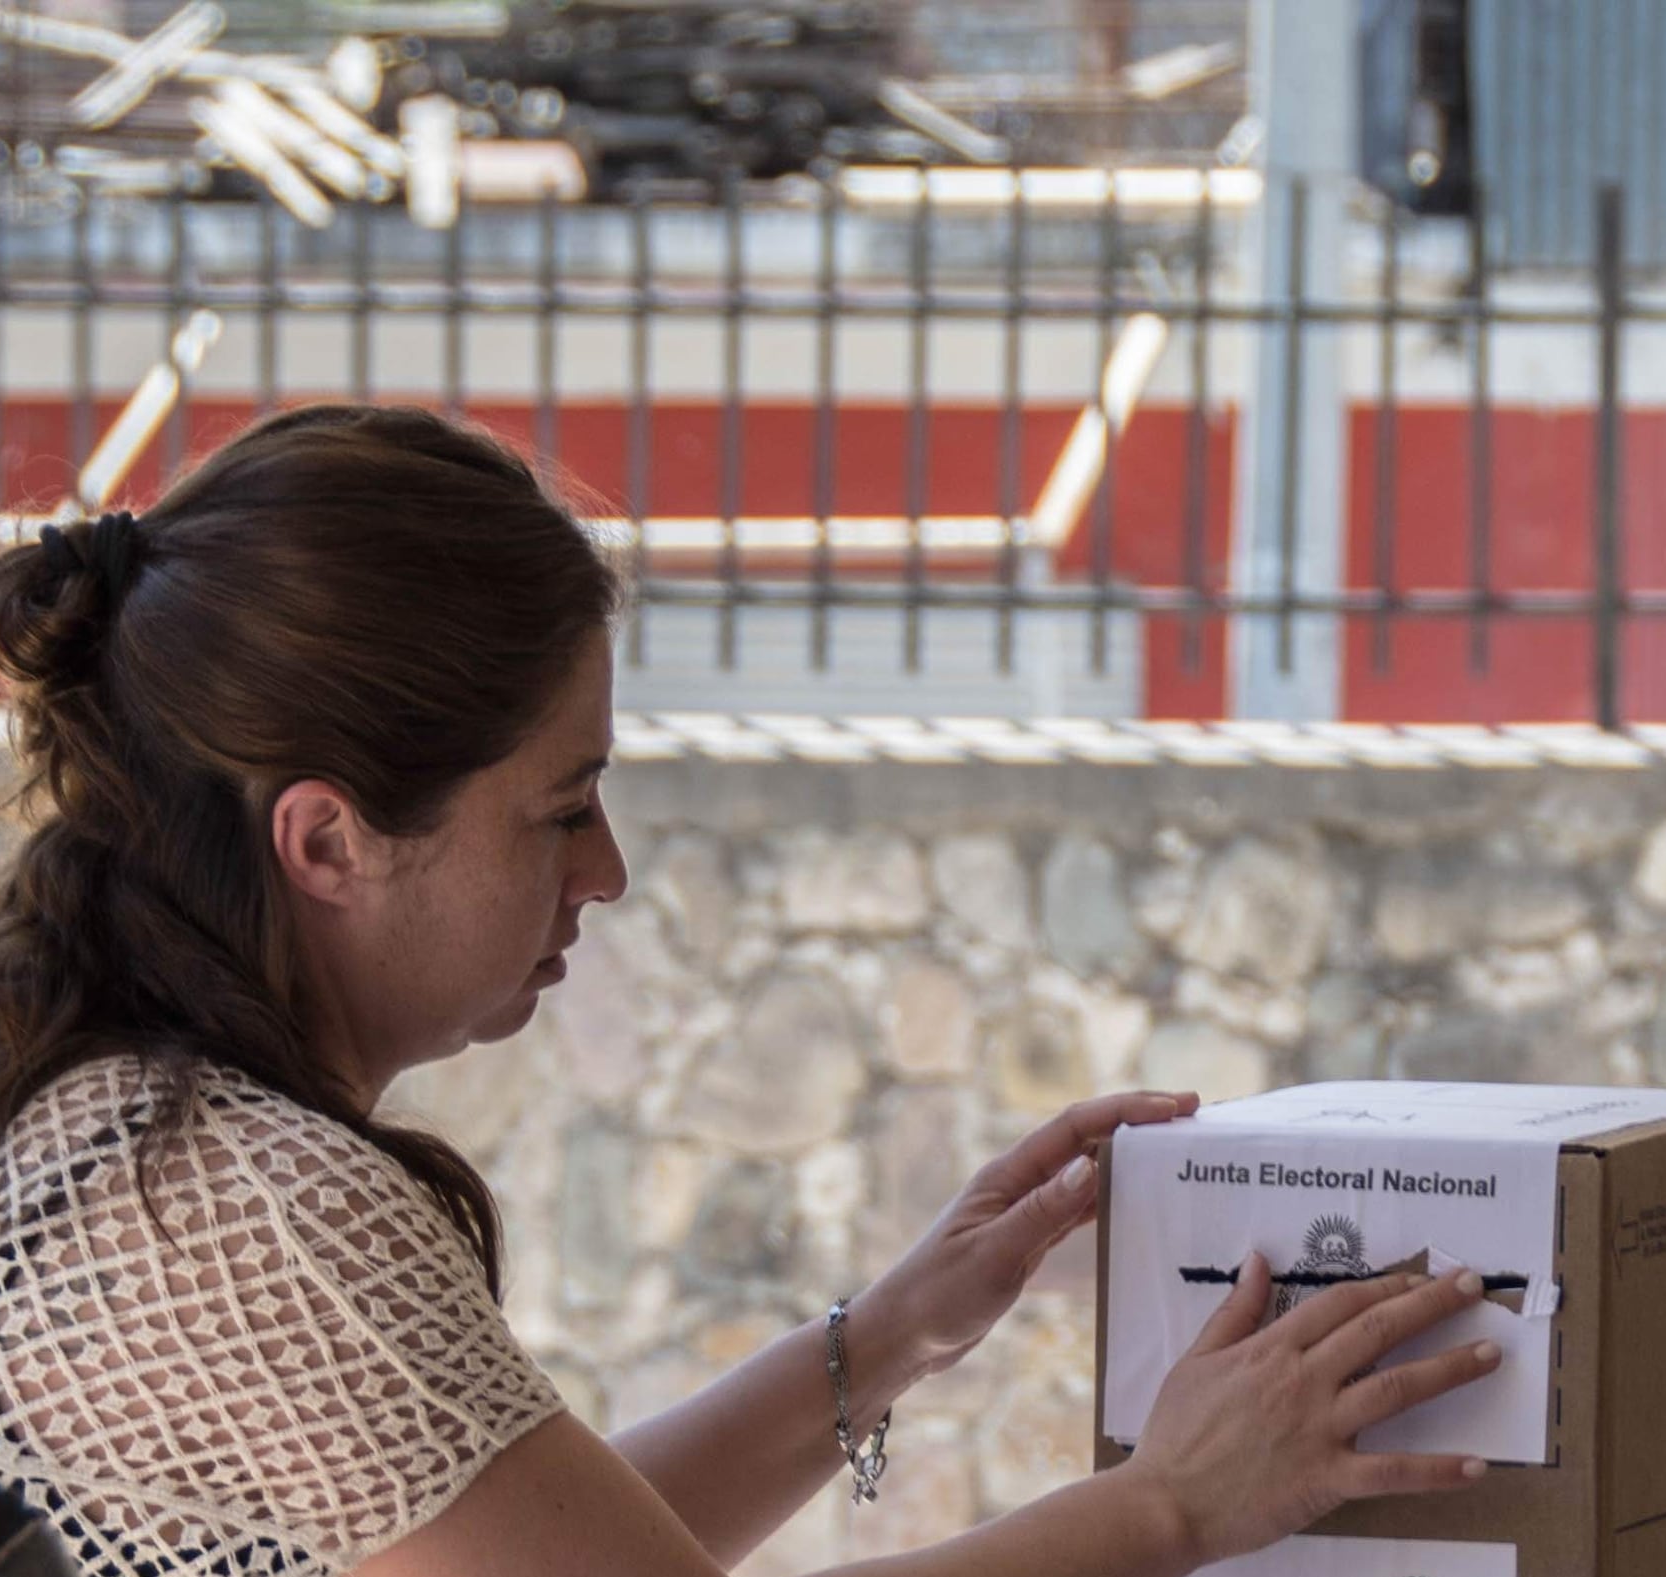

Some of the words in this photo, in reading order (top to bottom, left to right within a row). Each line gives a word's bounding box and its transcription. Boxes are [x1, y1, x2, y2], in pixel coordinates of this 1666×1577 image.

[1177, 1158, 1251, 1185] Junta
[1259, 1162, 1375, 1191] Electoral
[1383, 1168, 1497, 1198] Nacional
